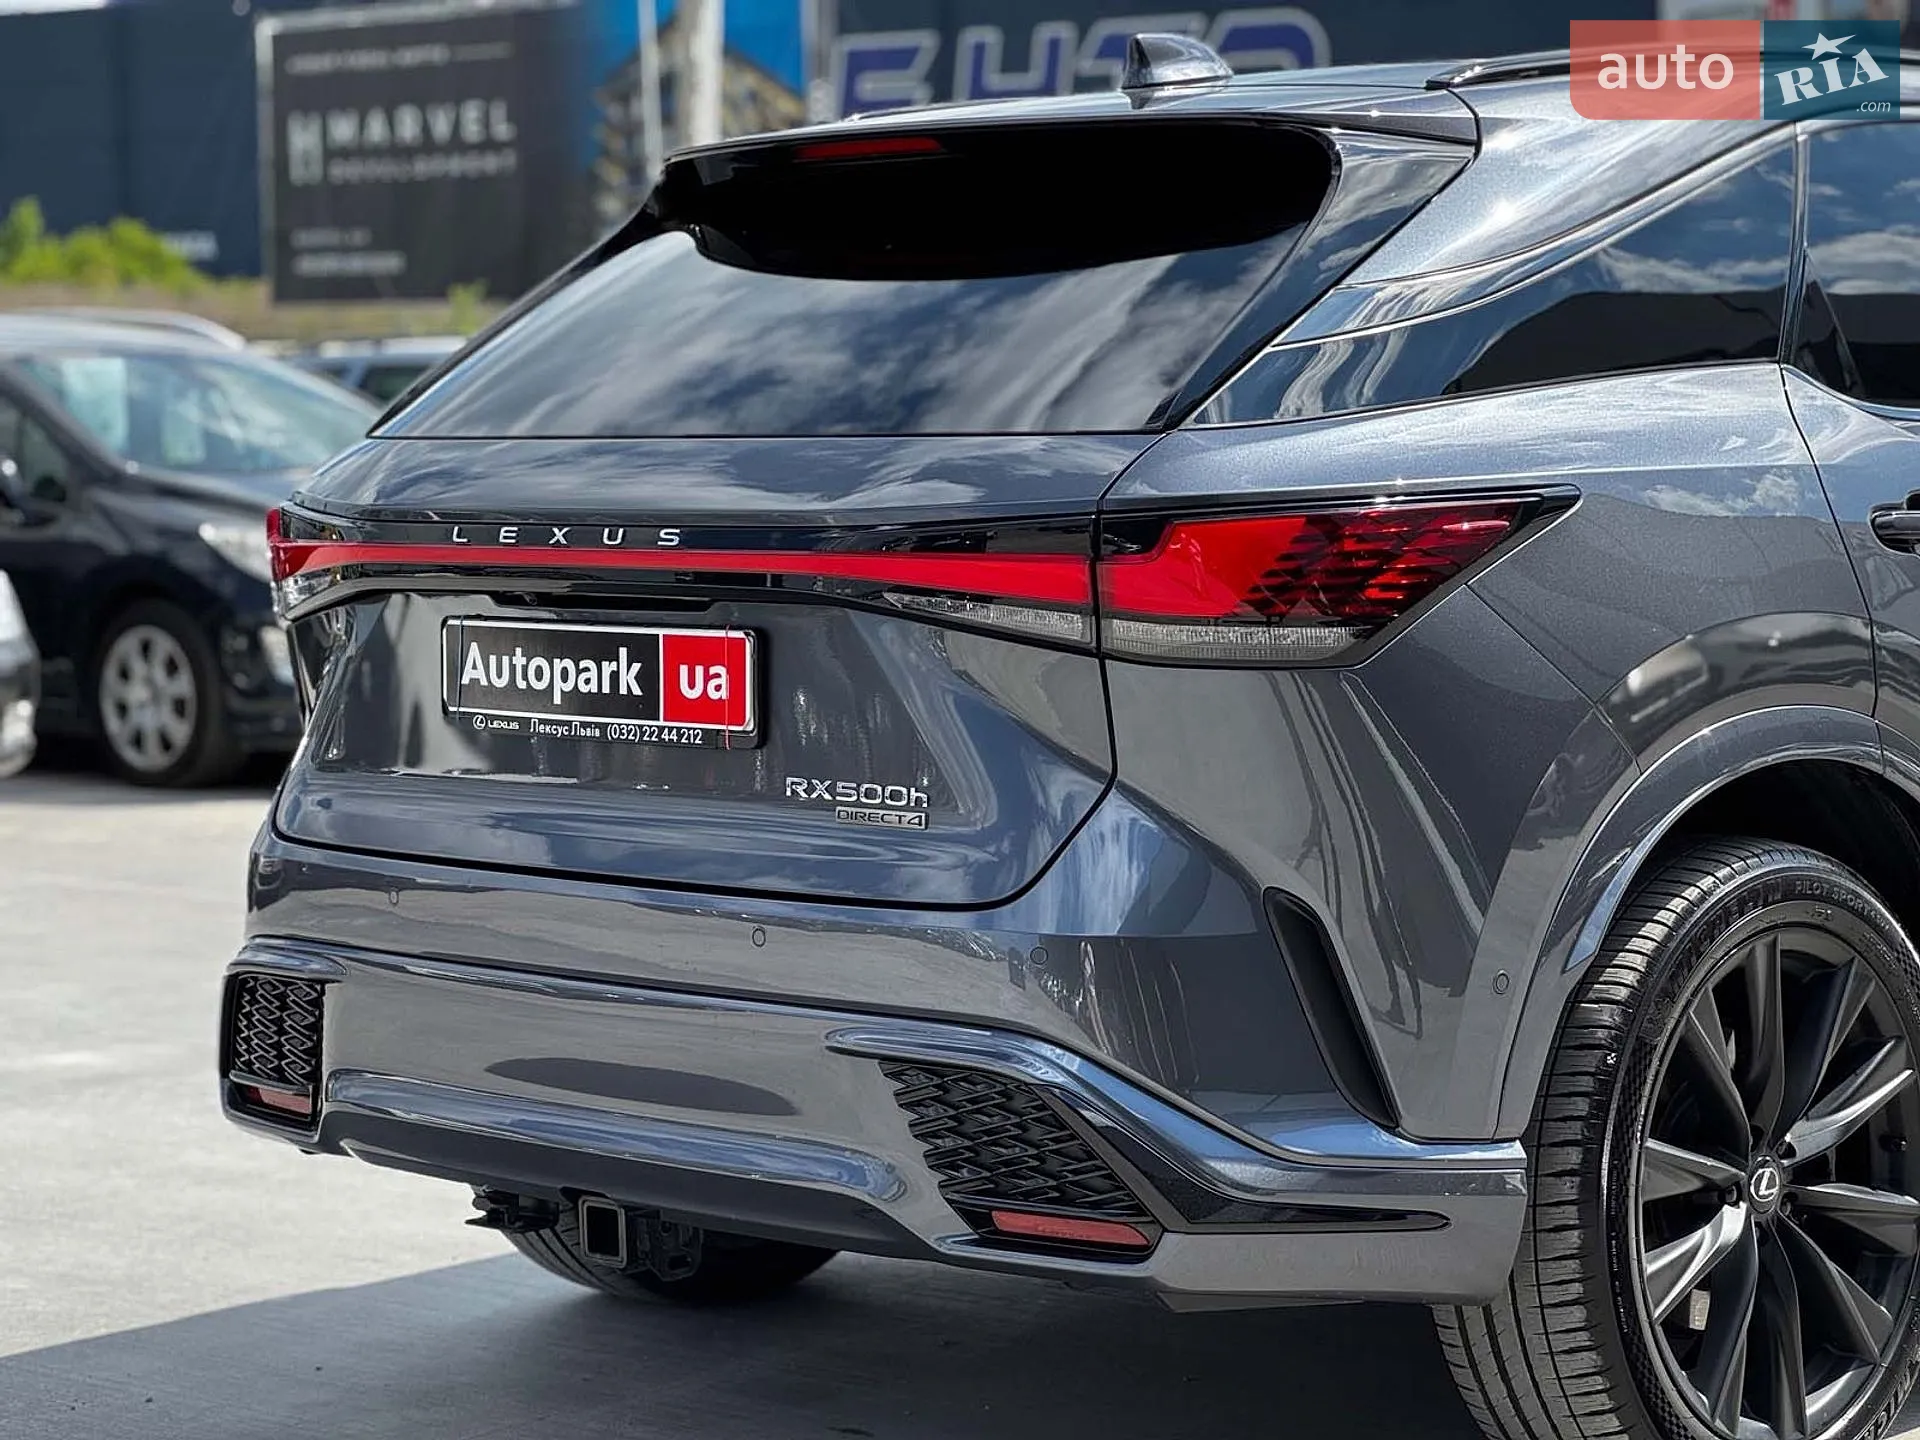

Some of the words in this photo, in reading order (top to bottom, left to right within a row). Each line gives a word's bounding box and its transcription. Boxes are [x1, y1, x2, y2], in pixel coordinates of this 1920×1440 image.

[452, 526, 681, 547] LEXUS
[460, 642, 643, 705] Autopark
[678, 663, 730, 700] ua
[488, 720, 520, 731] LEXUS
[529, 718, 569, 738] Лексус
[607, 724, 641, 743] (032)
[642, 727, 659, 741] 22
[661, 727, 678, 742] 44
[680, 728, 703, 744] 212
